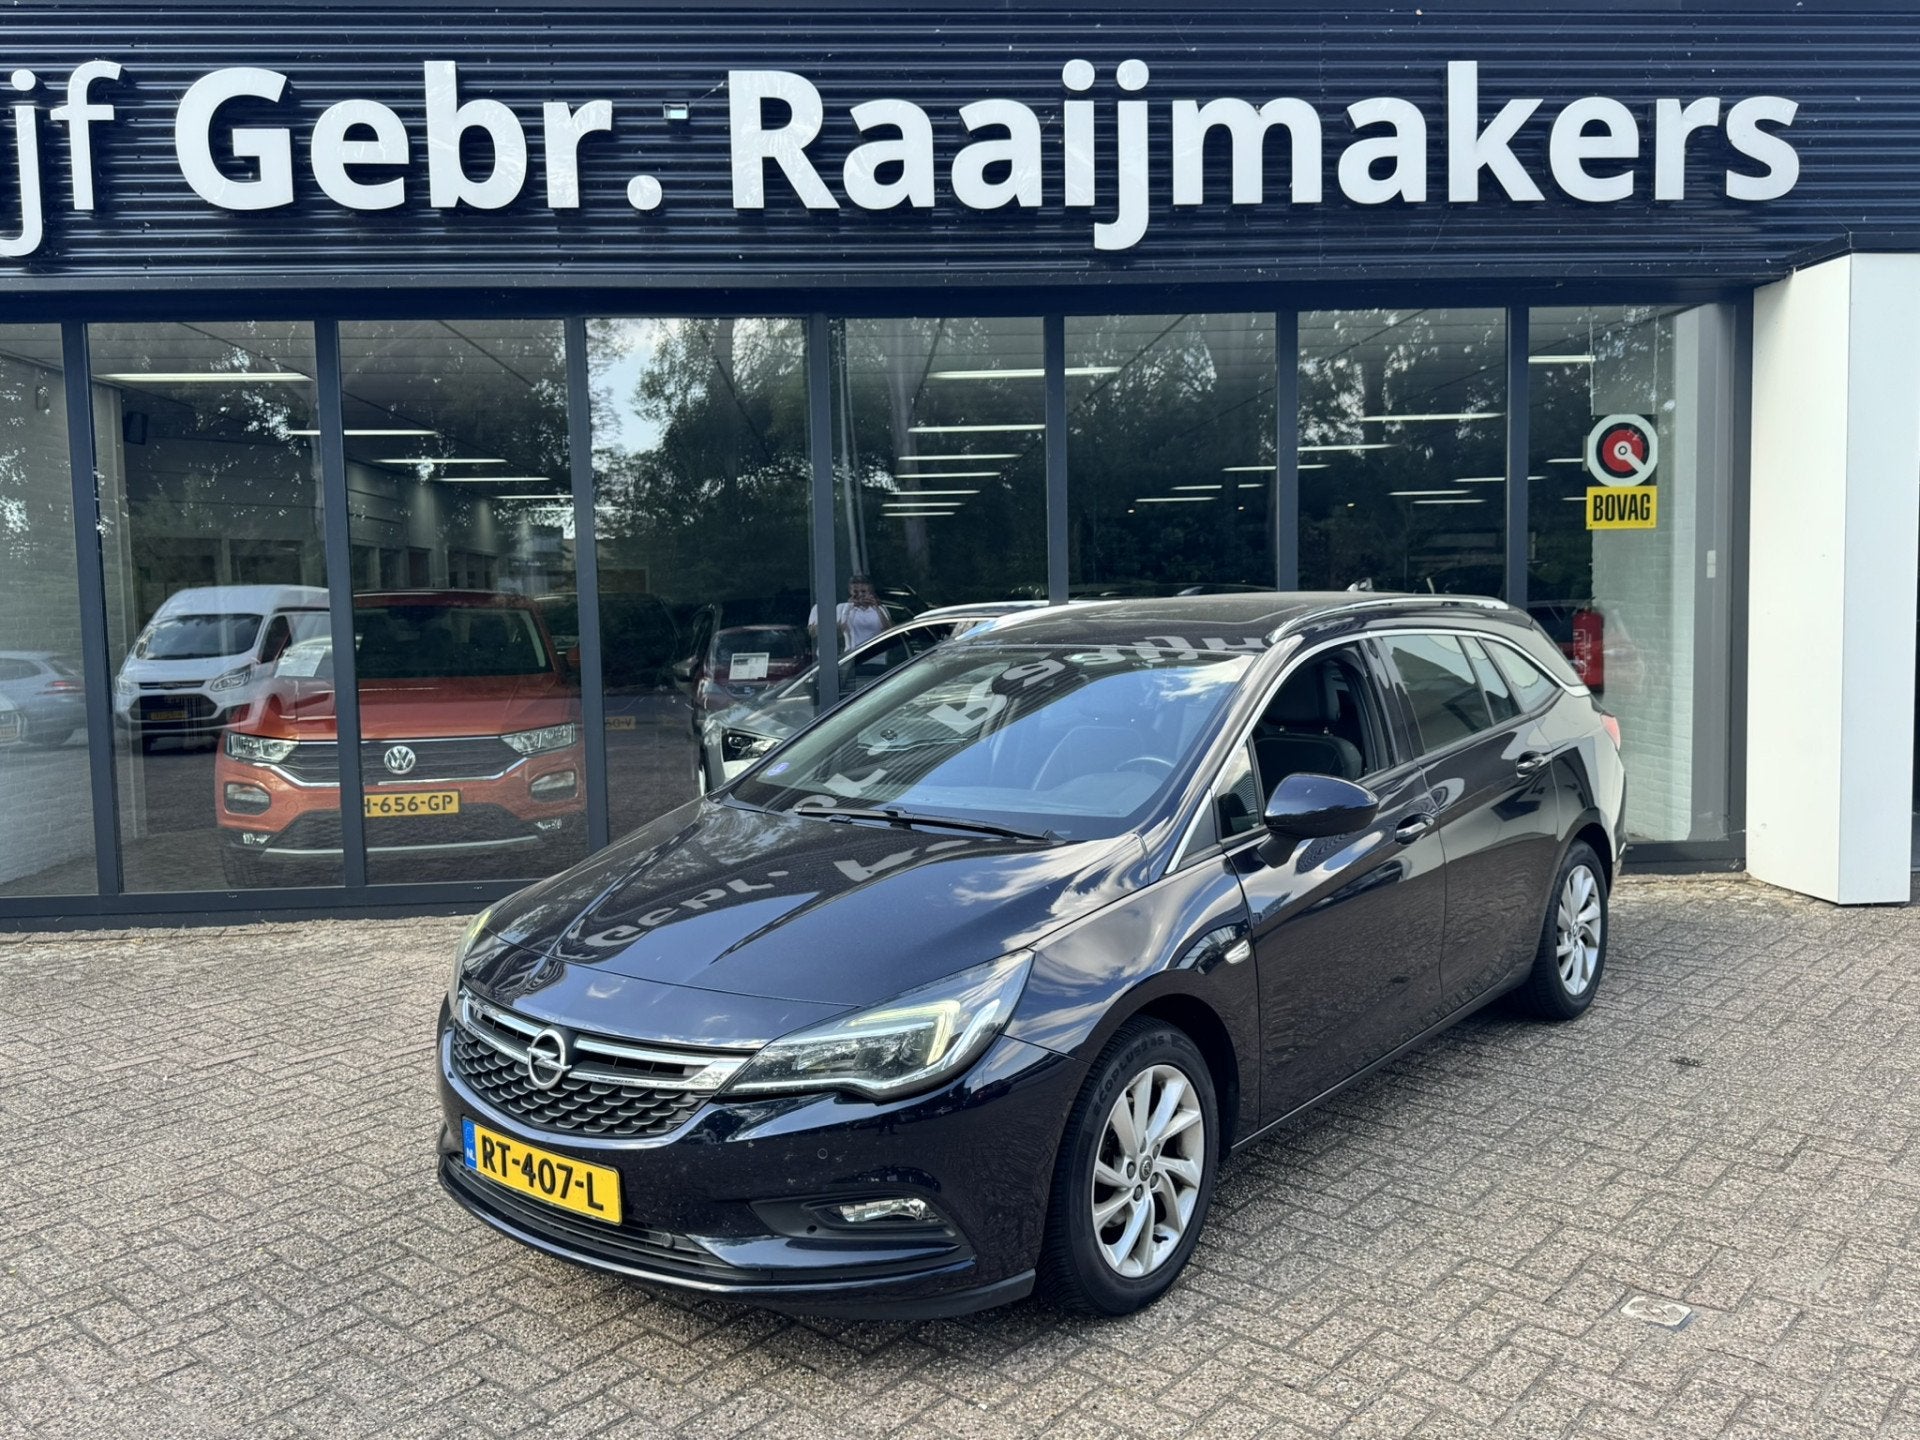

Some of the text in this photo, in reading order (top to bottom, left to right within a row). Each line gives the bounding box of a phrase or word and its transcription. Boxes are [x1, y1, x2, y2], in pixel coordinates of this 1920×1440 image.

[0, 58, 1800, 257] jf Gebr. Raaijmakers
[1593, 493, 1651, 521] BOVAG
[466, 1147, 476, 1161] NL
[481, 1134, 604, 1212] RT-407-L
